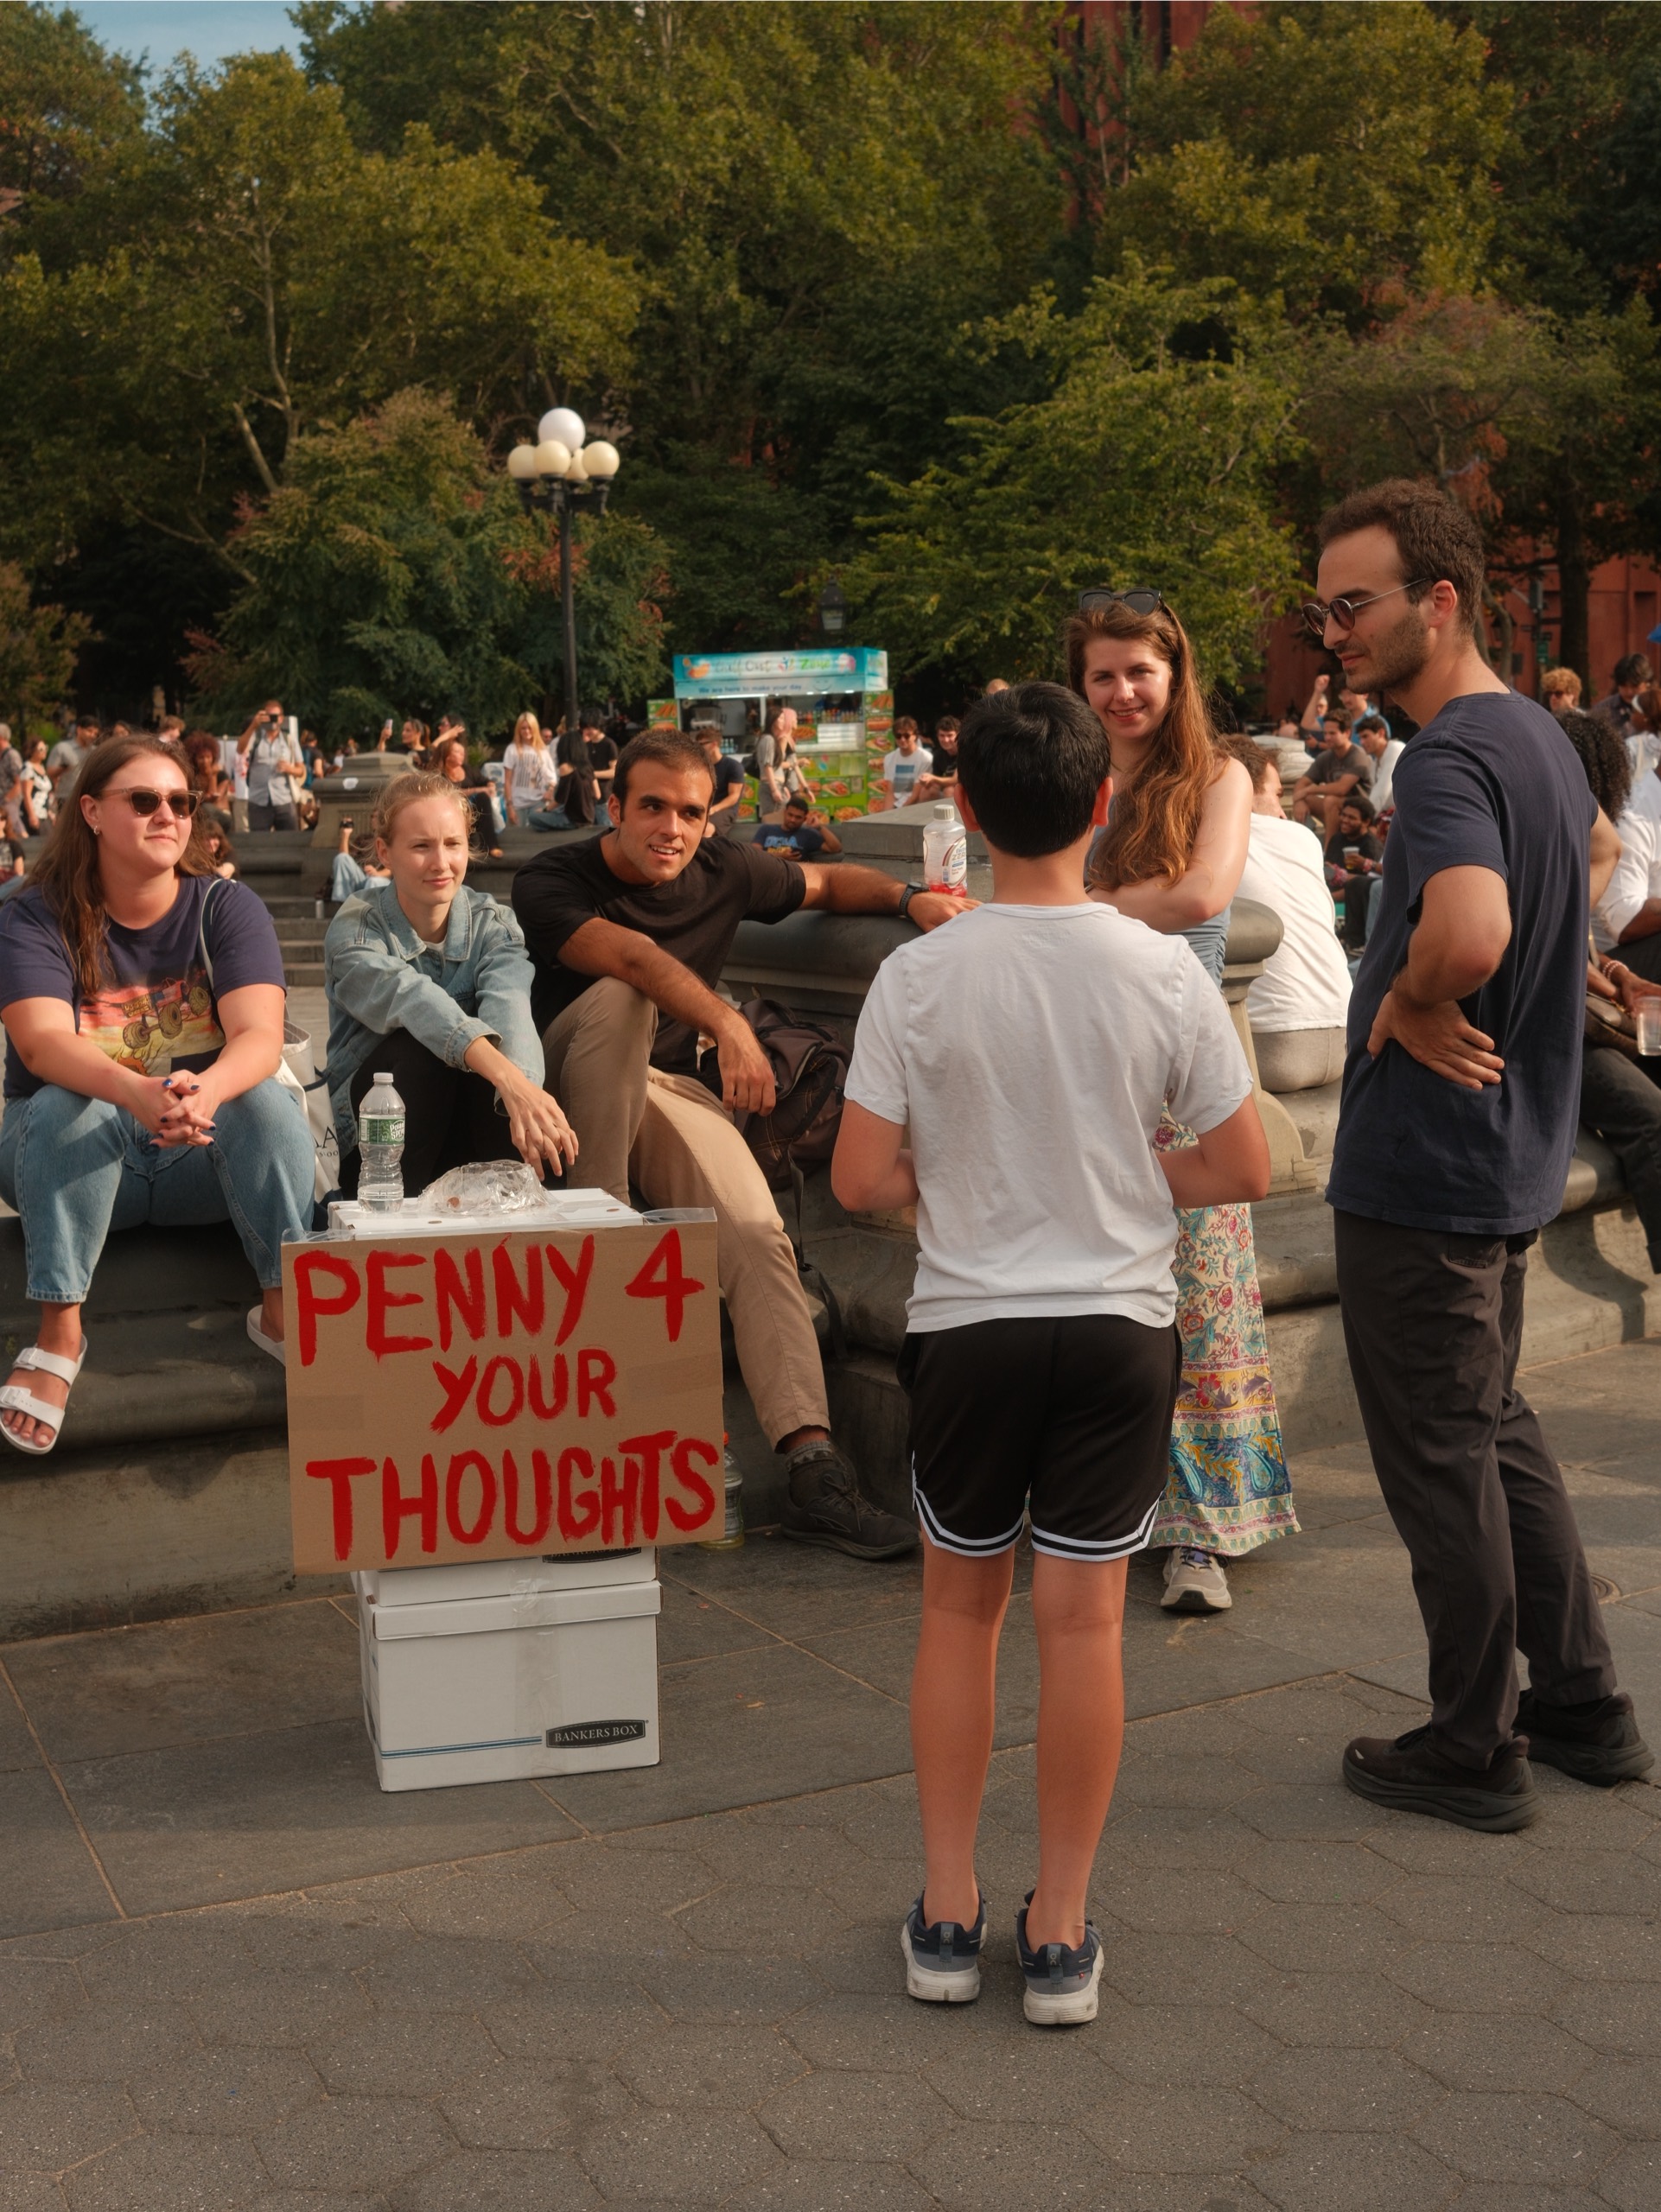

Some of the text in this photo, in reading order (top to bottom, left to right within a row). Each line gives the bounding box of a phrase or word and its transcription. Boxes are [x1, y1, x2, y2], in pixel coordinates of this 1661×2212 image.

[294, 1228, 705, 1367] PENNY 4
[430, 1349, 617, 1434] YOUR
[306, 1430, 720, 1562] THOUGHTS
[555, 1724, 639, 1743] BANKERS BOX
